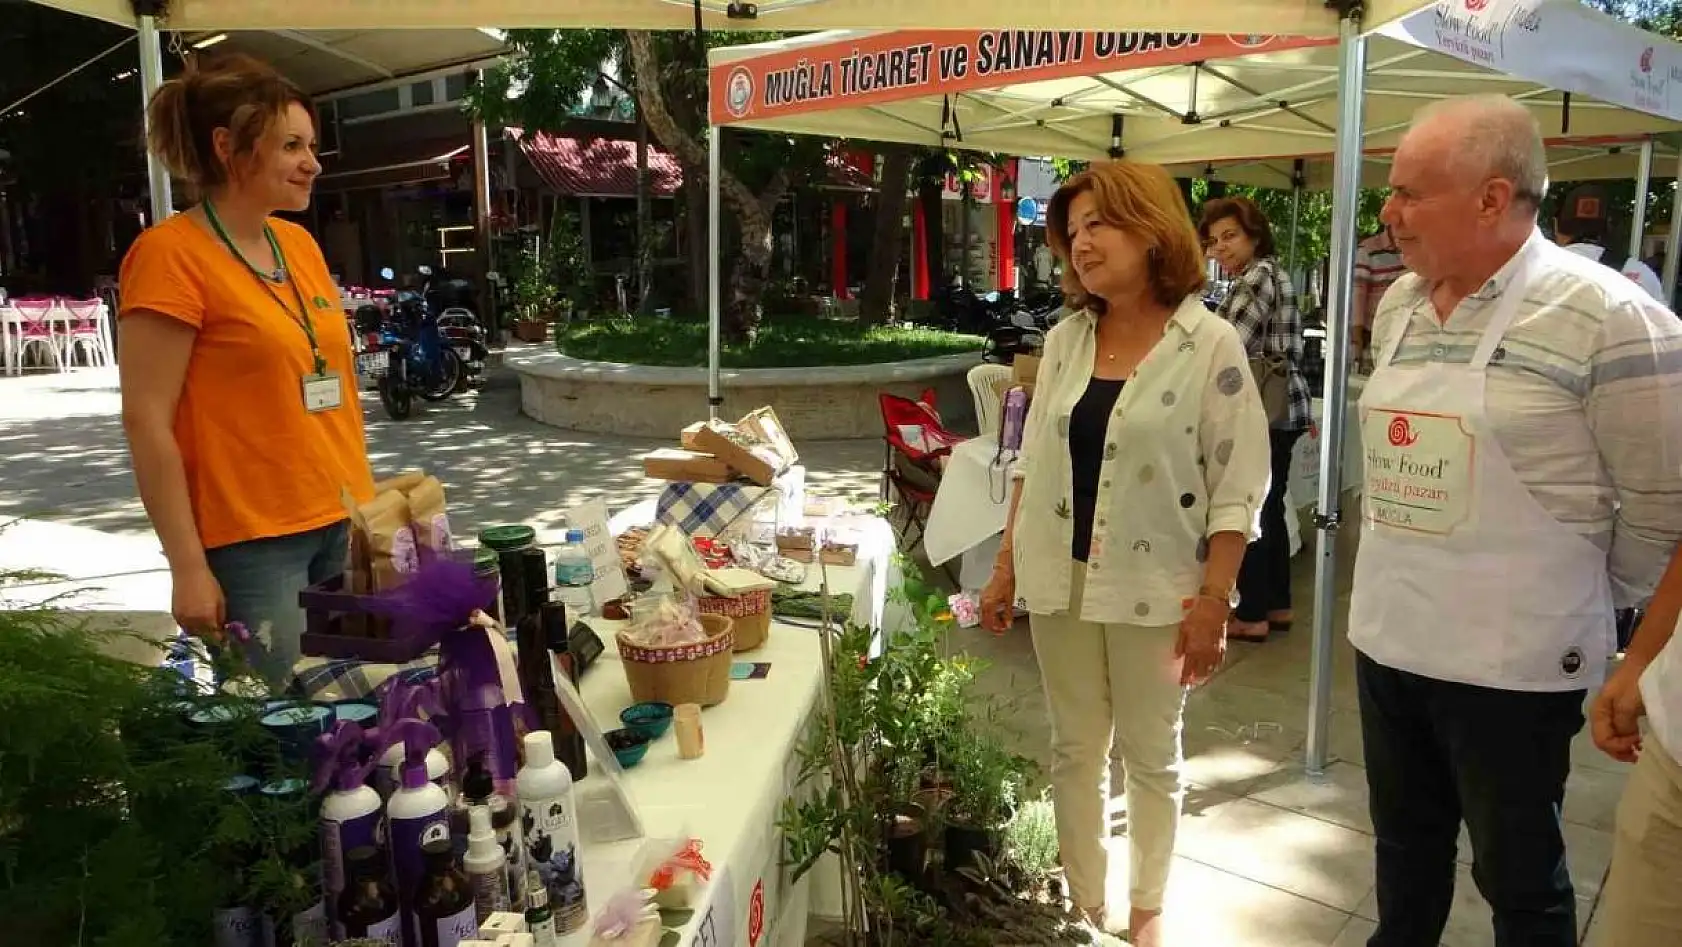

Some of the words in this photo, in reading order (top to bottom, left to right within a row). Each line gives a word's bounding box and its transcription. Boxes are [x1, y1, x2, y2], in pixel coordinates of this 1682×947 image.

[764, 57, 834, 108] MUĞLA
[840, 43, 933, 96] TİCARET
[938, 43, 969, 81] ve
[1399, 452, 1442, 479] Food
